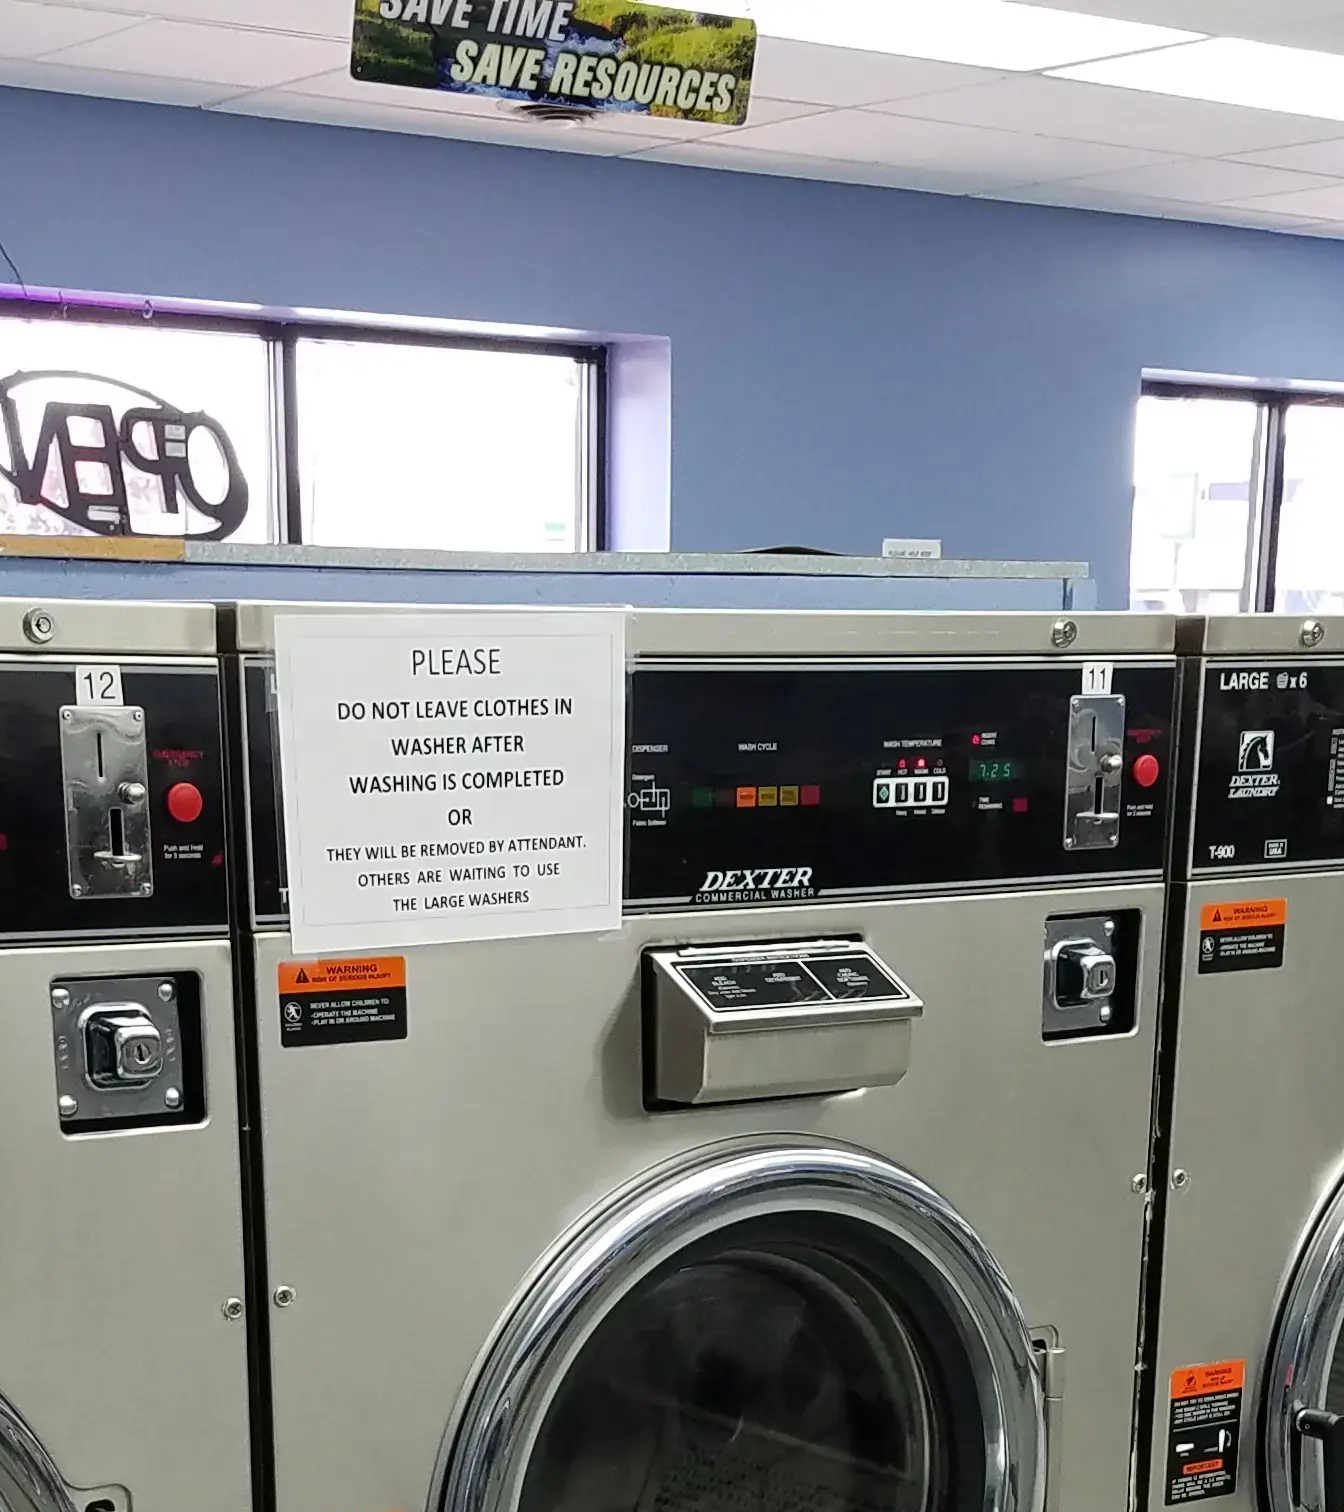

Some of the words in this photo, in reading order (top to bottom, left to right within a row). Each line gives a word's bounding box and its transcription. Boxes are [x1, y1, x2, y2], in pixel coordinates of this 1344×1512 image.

[486, 0, 573, 41] TIME
[450, 39, 546, 91] SAVE
[550, 52, 737, 112] RESOURCES
[412, 648, 501, 675] PLEASE
[84, 672, 116, 699] 12
[1089, 668, 1105, 689] 11
[1220, 672, 1269, 690] LARGE
[1289, 678, 1297, 688] x
[1299, 672, 1307, 688] 6
[338, 702, 365, 720] DO
[372, 702, 410, 720] NOT
[416, 701, 468, 718] LEAVE
[474, 699, 548, 717] CLOTHES
[555, 698, 572, 715] IN
[392, 737, 466, 756] WASHER
[472, 735, 524, 753] AFTER
[349, 775, 436, 794] WASHING
[443, 774, 456, 790] IS
[462, 769, 564, 789] COMPLETED
[1228, 787, 1279, 798] LAUNDRY
[448, 809, 472, 825] OR
[327, 848, 360, 862] THEY
[365, 846, 397, 861] WILL
[402, 845, 416, 858] BE
[421, 840, 484, 858] REMOVED
[489, 840, 504, 853] BY
[508, 835, 587, 852] ATTENDANT.
[1209, 845, 1235, 859] T-900
[358, 872, 410, 887] OTHERS
[417, 869, 442, 884] ARE
[449, 866, 506, 882] WAITING
[513, 864, 530, 878] TO
[537, 862, 560, 877] USE
[699, 867, 812, 891] DEXTER
[393, 898, 417, 912] THE
[424, 894, 464, 910] LARGE
[469, 890, 529, 907] WASHERS
[696, 891, 766, 903] COMMERCIAL
[771, 888, 814, 898] WASHER
[326, 964, 378, 974] WARNING
